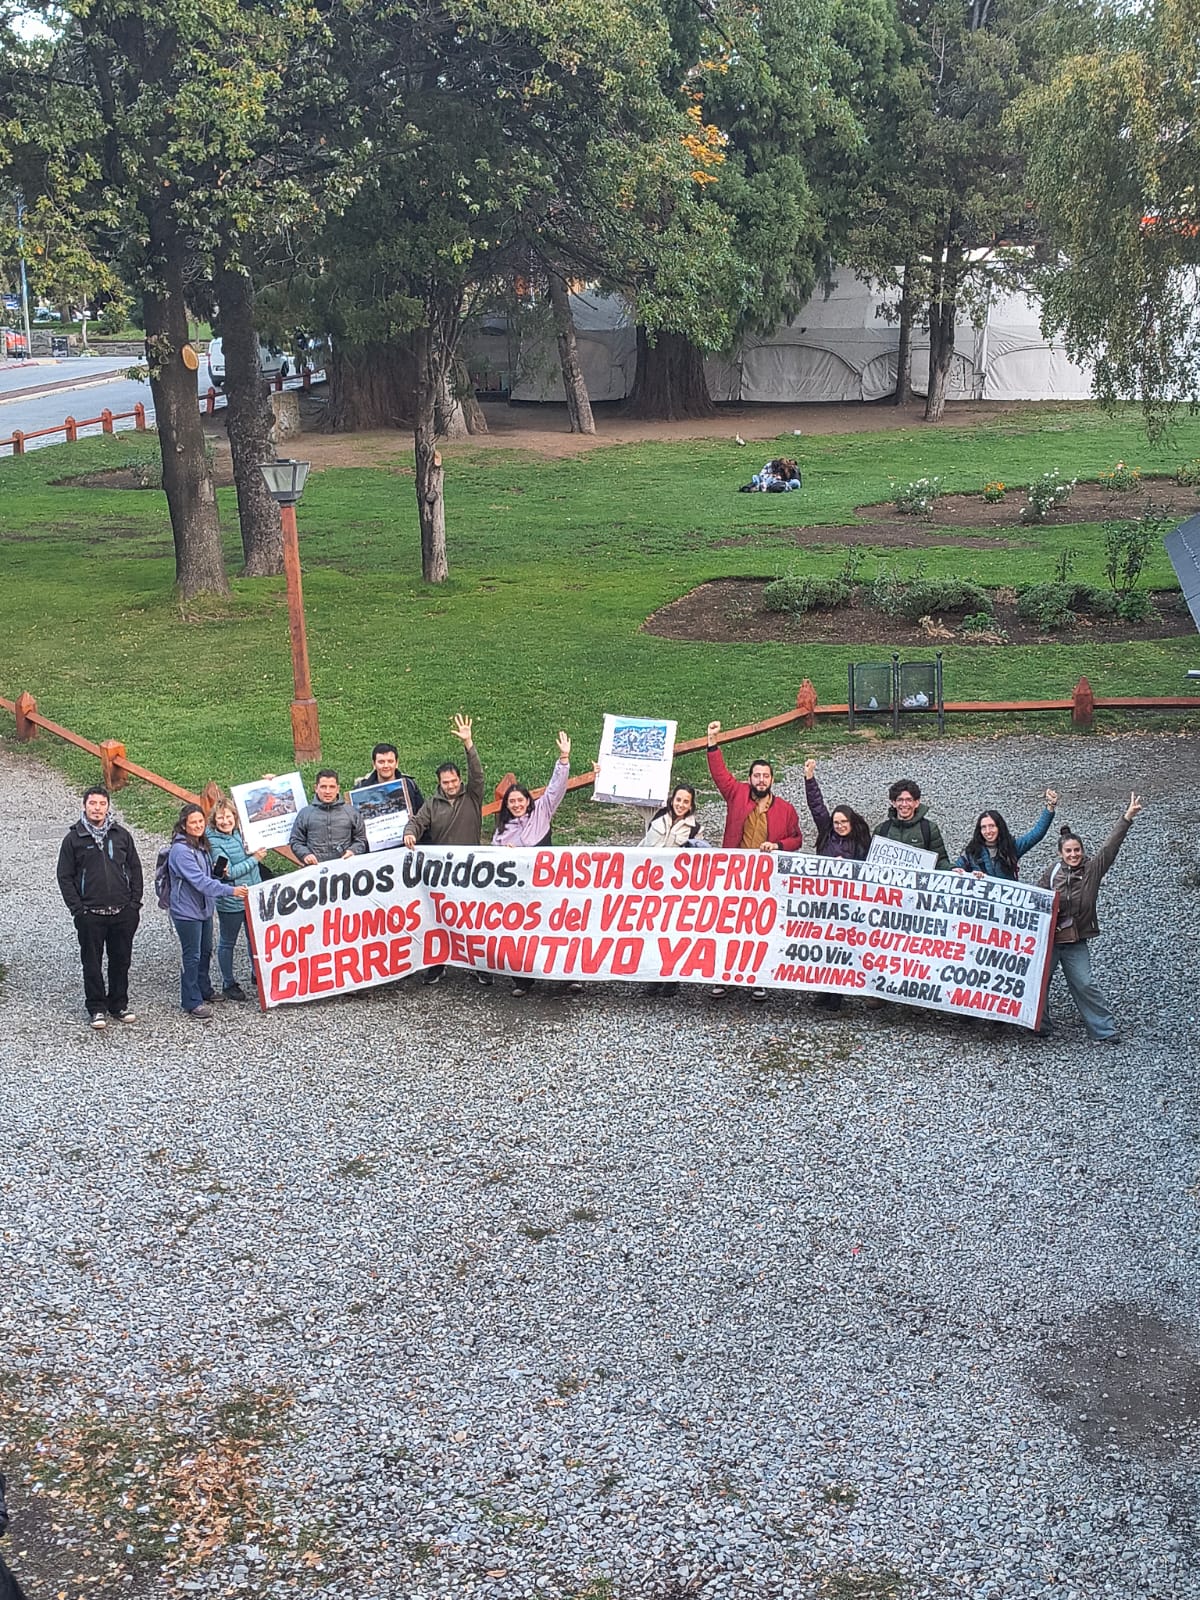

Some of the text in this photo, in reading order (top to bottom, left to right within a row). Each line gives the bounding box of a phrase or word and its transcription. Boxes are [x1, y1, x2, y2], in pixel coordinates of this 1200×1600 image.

[258, 850, 774, 922] Vecinos Unidos. BASTA de SUFRIR
[788, 876, 903, 907] FRUTILLAR
[790, 857, 853, 879] REINA
[858, 864, 917, 888] MORA
[926, 873, 988, 899] VALLE
[988, 884, 1035, 909] AZUL
[786, 899, 948, 937] LOMAS de CAUQUEN
[916, 892, 1040, 932] NAHUEL HUE
[264, 923, 314, 962] Por
[548, 898, 589, 932] del
[600, 894, 778, 936] VERTEDERO
[785, 920, 966, 961] Villa Lago GUTIERREZ
[957, 921, 1012, 950] PILAR
[269, 936, 413, 1002] CIERRE
[422, 929, 645, 975] DEFINITIVO
[785, 943, 823, 962] 400
[862, 952, 901, 975] 645
[774, 963, 866, 988] MALVINAS
[875, 975, 943, 1003] 2 de ABRIL
[991, 974, 1026, 998] 258
[950, 988, 1022, 1018] MAITEN
